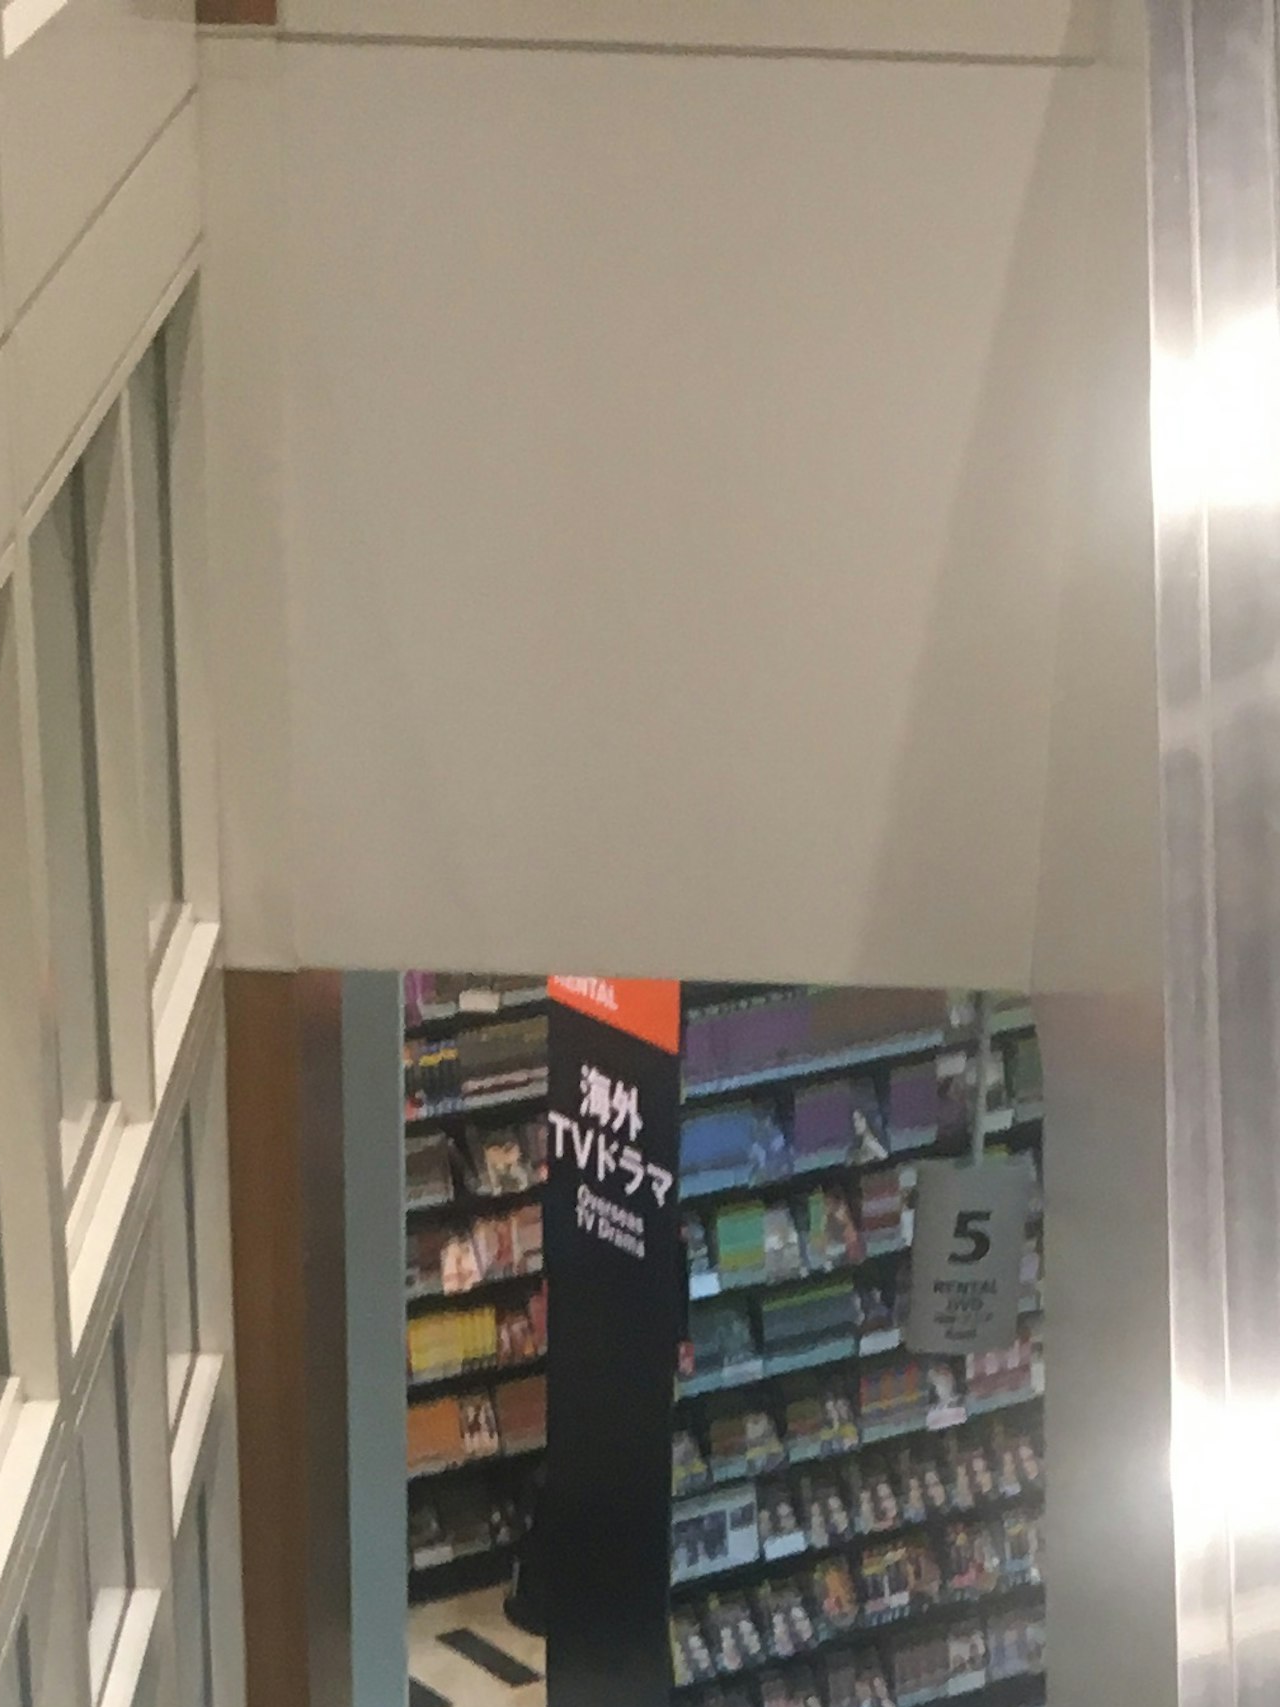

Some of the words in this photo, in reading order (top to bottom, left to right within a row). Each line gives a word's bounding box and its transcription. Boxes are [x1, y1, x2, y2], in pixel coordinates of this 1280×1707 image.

[580, 1064, 643, 1142] 海外
[548, 1110, 673, 1208] TVドラマ
[575, 1204, 596, 1232] TV
[947, 1211, 991, 1264] 5
